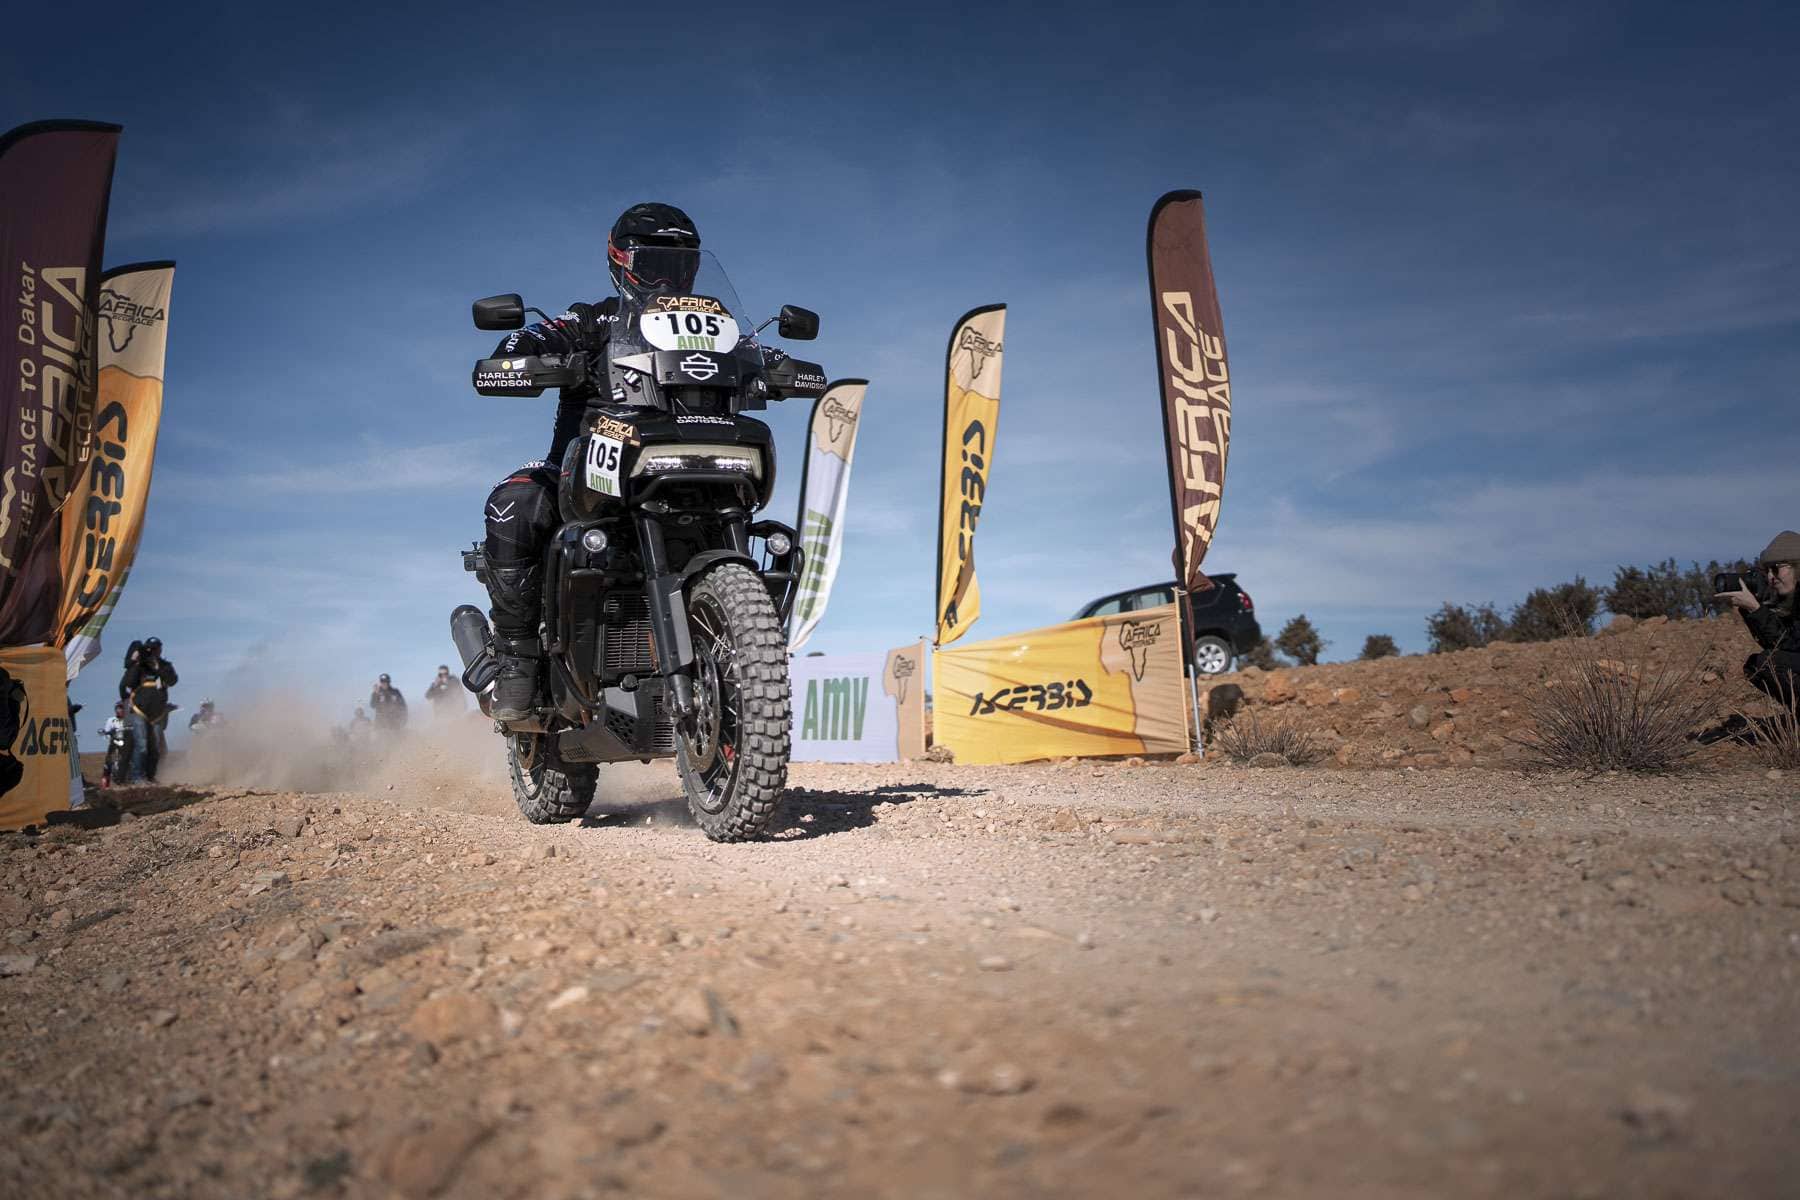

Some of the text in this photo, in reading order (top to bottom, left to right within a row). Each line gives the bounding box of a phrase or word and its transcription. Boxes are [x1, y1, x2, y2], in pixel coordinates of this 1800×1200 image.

[18, 261, 36, 346] Dakar
[99, 299, 165, 321] AFRICA
[667, 296, 721, 311] AFRICA
[667, 313, 720, 336] 105
[21, 358, 36, 392] TO
[797, 373, 825, 382] HARLEY
[21, 408, 36, 478] RACE
[588, 439, 620, 471] 105
[1124, 624, 1161, 645] AFRICA
